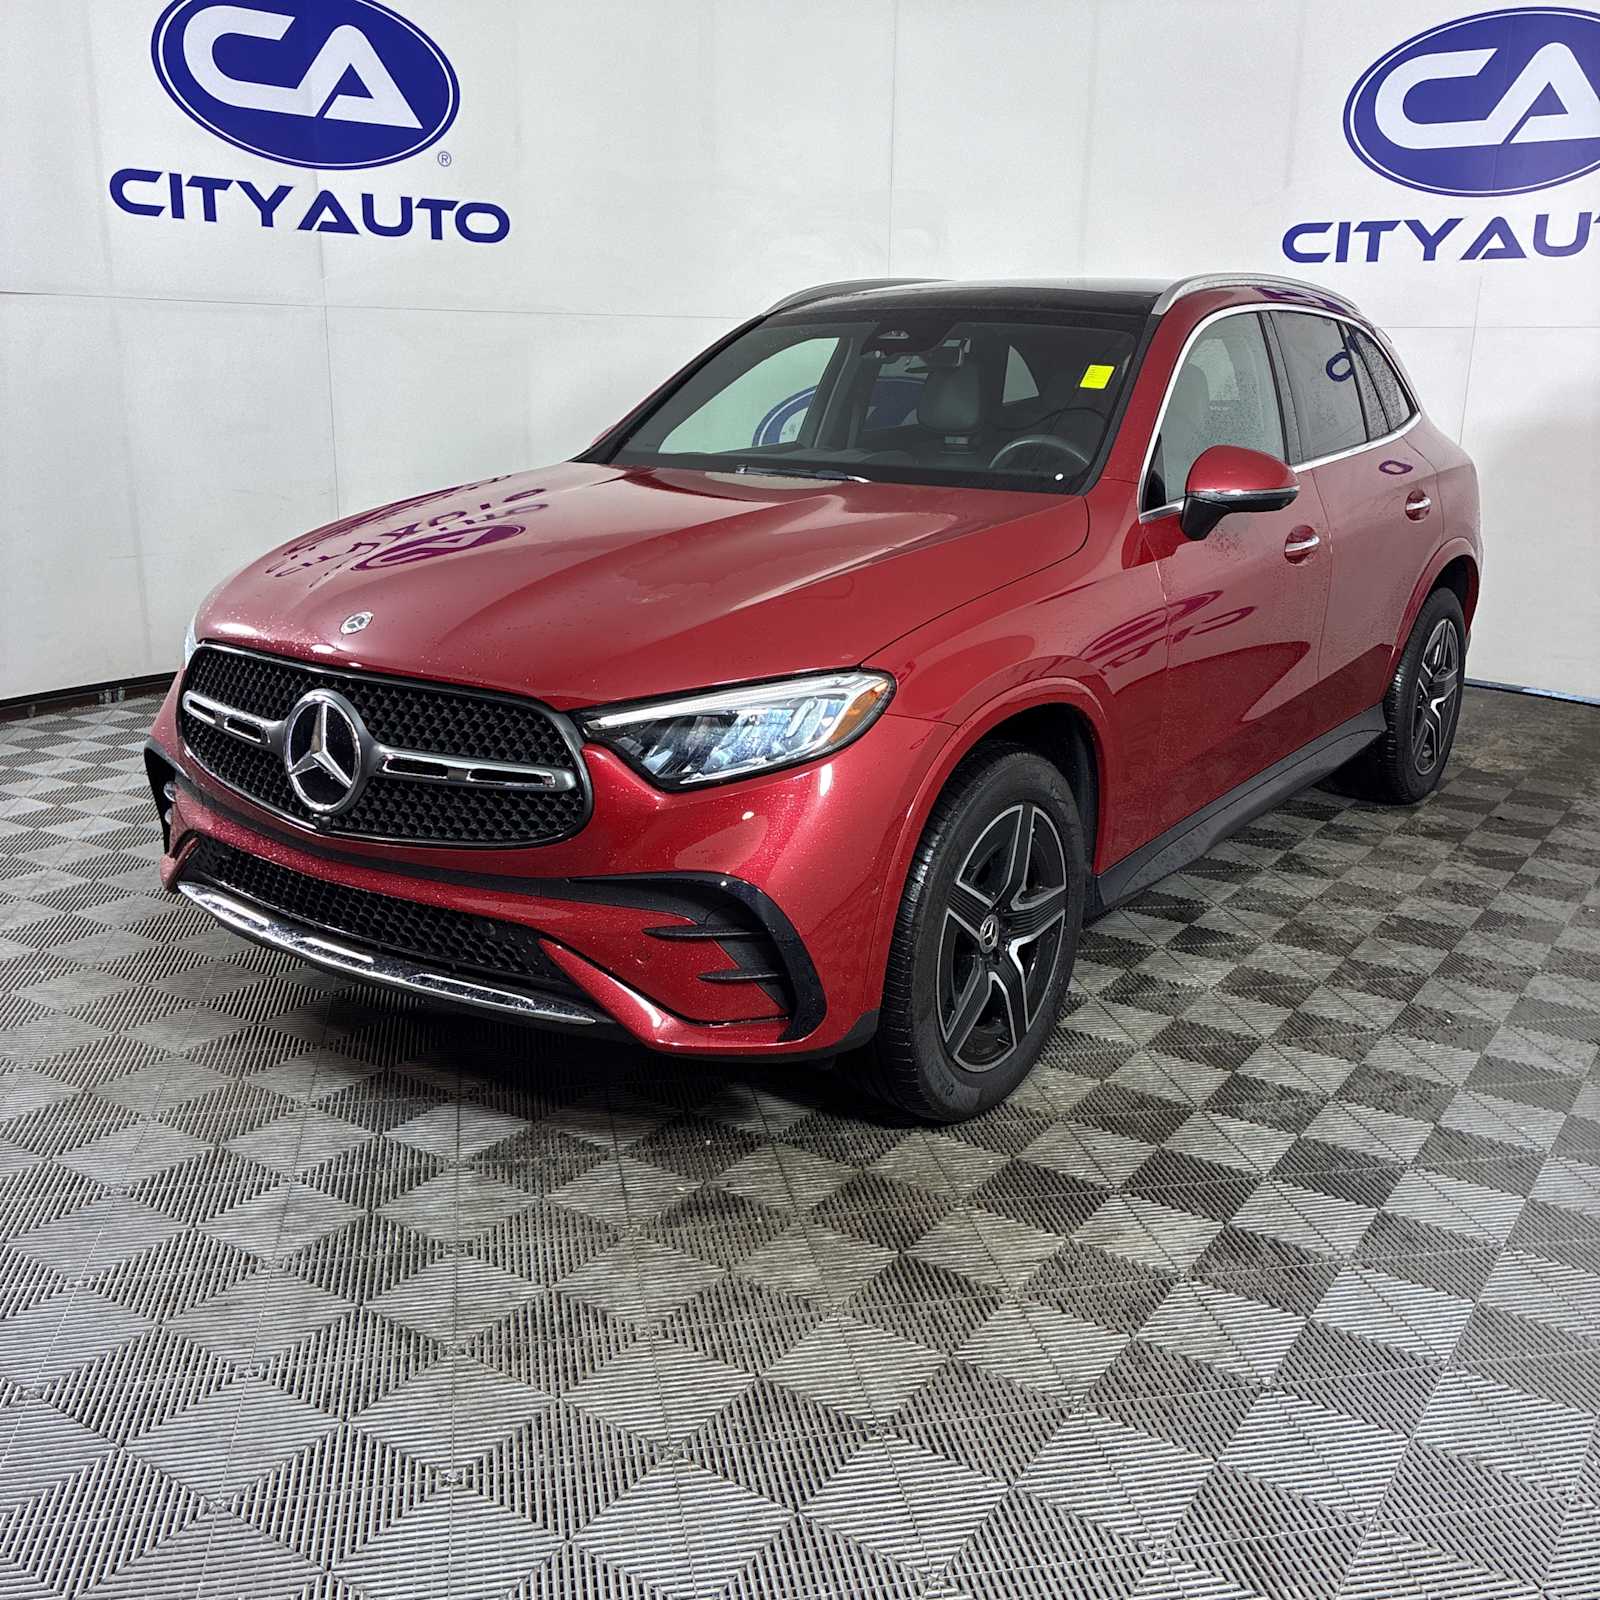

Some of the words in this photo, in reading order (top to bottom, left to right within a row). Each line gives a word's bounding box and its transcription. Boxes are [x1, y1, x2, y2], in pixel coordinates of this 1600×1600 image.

[183, 5, 423, 129] CA
[1375, 42, 1600, 150] CA
[1459, 211, 1600, 261] AU
